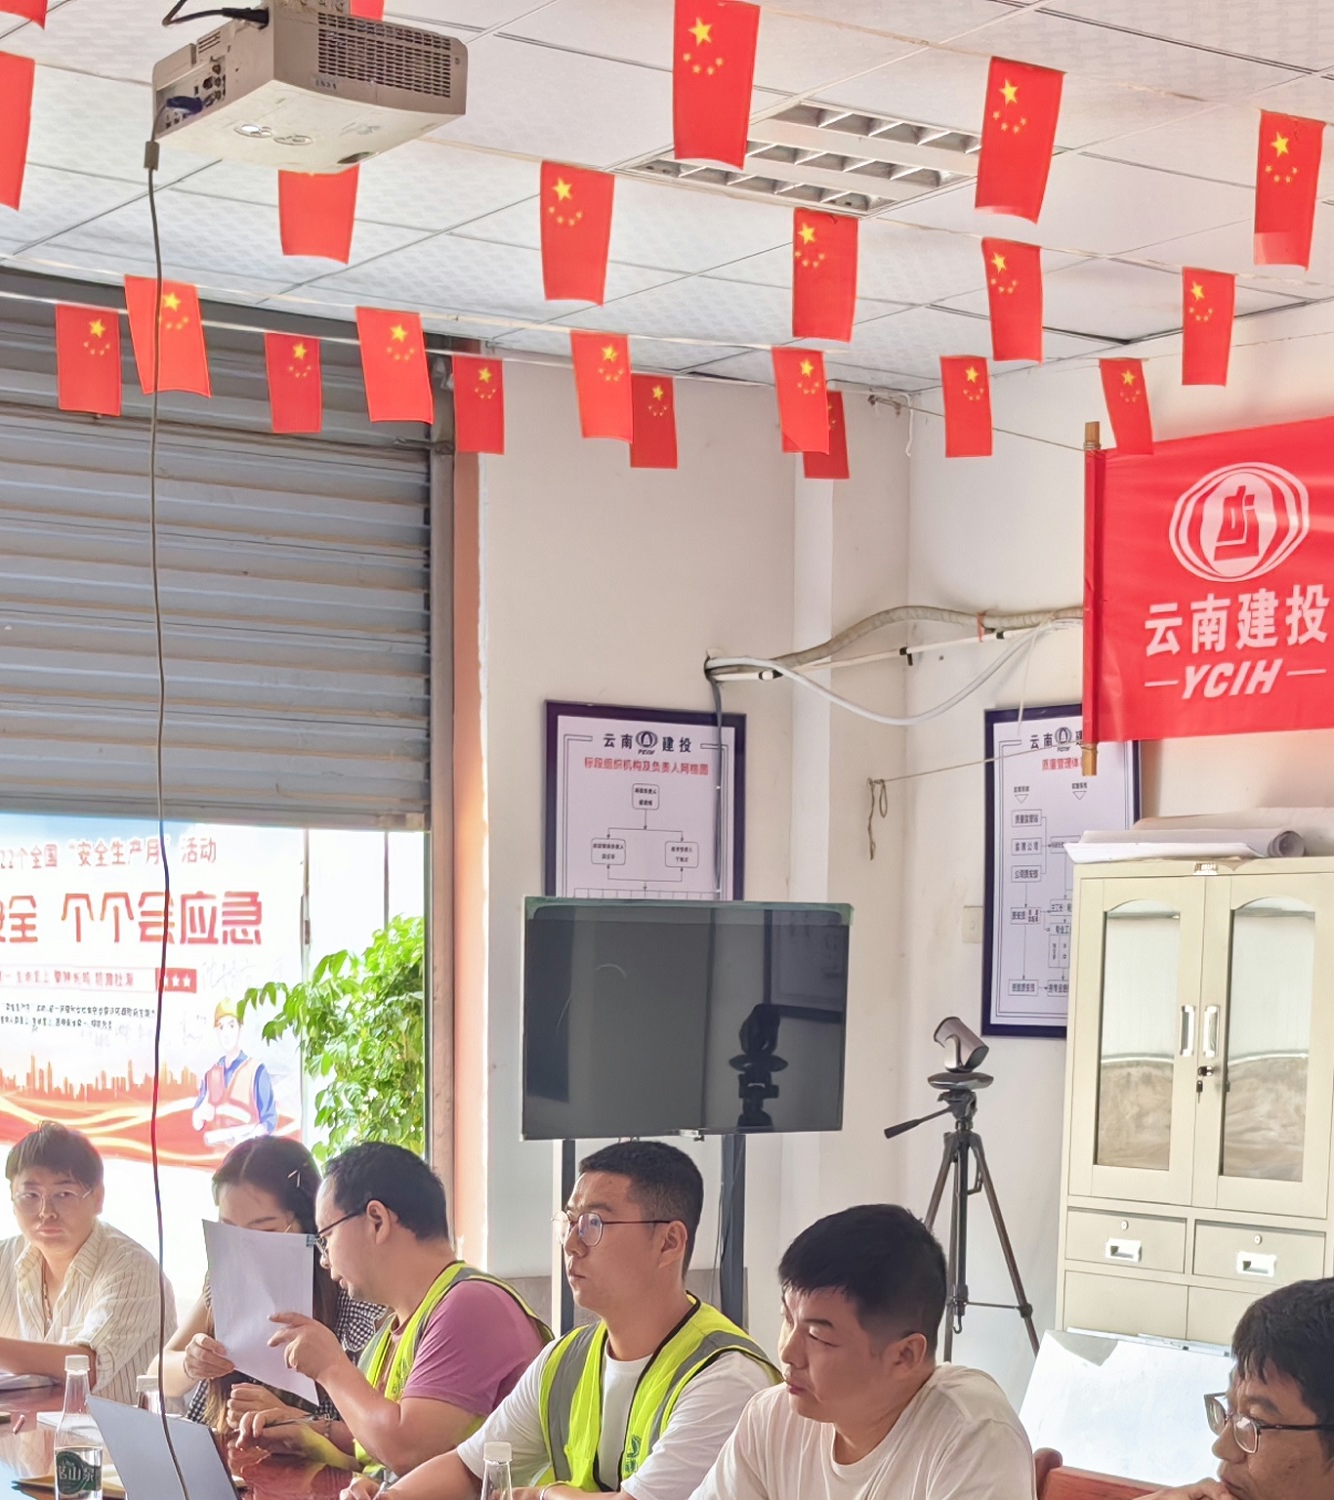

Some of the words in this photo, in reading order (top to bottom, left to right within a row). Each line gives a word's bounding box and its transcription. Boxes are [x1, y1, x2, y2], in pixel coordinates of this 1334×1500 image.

[1144, 584, 1330, 657] 云南建投
[1182, 658, 1284, 699] YCIH
[61, 890, 263, 945] 个个会应急
